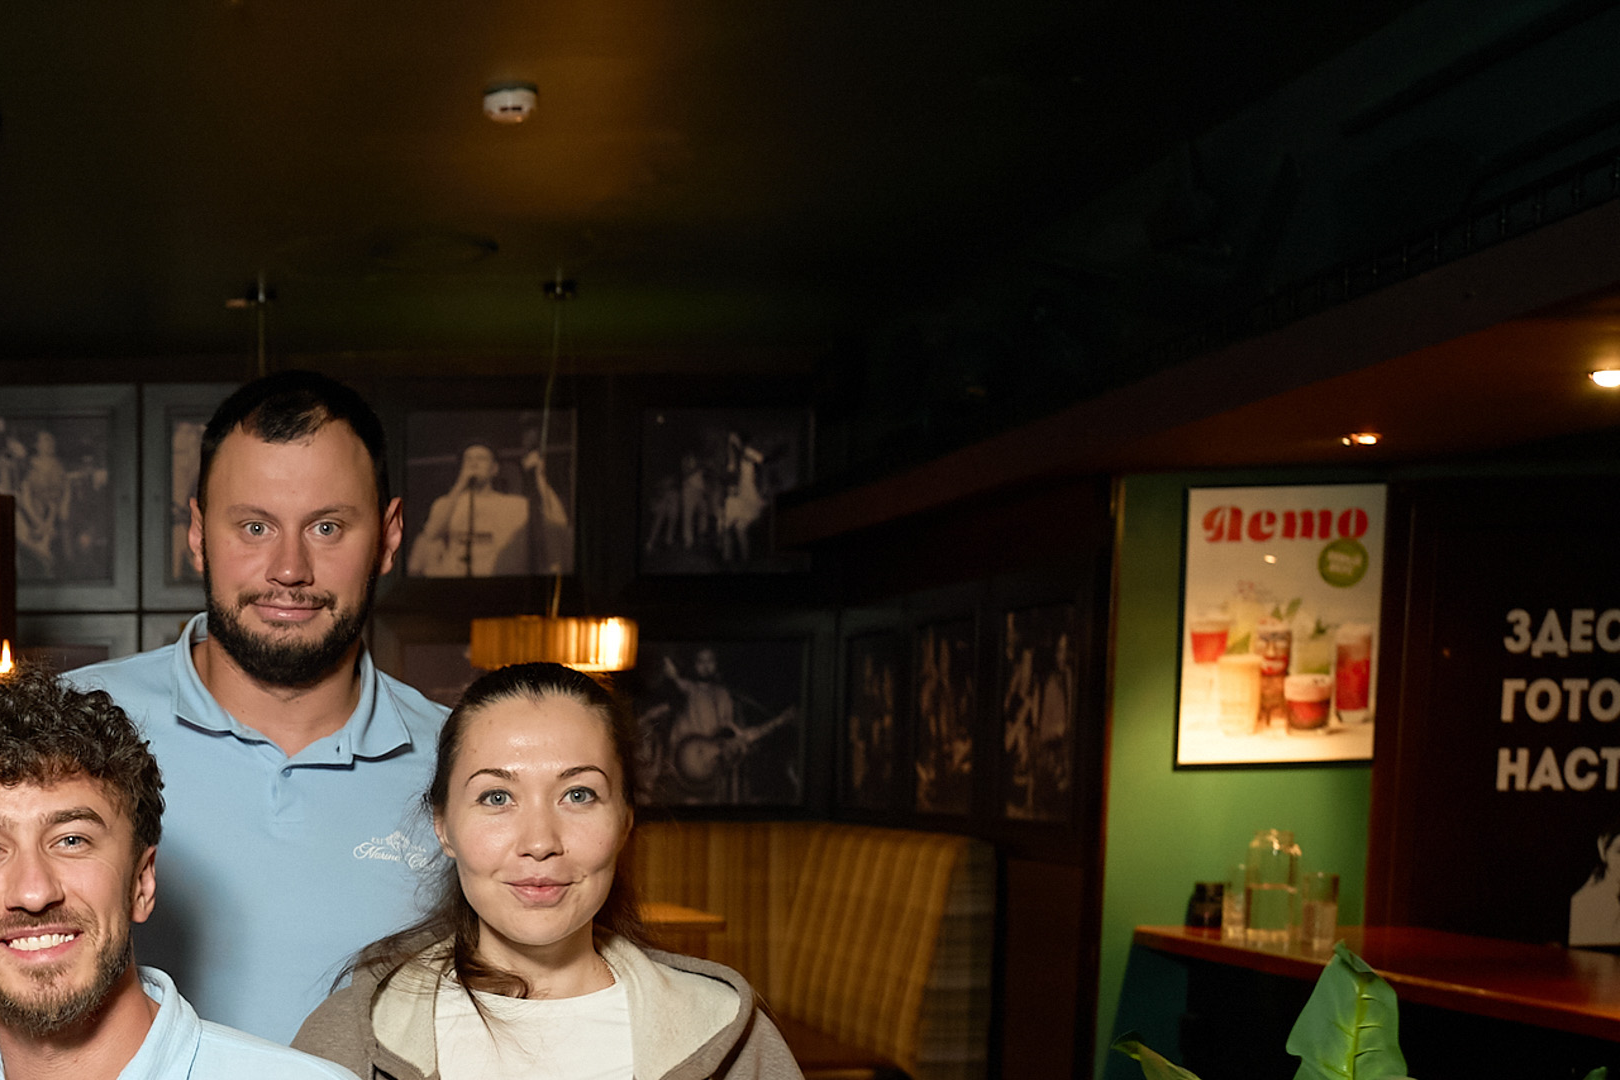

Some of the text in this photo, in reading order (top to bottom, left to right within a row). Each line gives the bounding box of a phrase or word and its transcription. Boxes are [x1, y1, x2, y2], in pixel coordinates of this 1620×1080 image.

[1503, 608, 1620, 658] ЗДЕС
[1501, 678, 1620, 722] ГОТО
[1496, 747, 1620, 791] НАСТ
